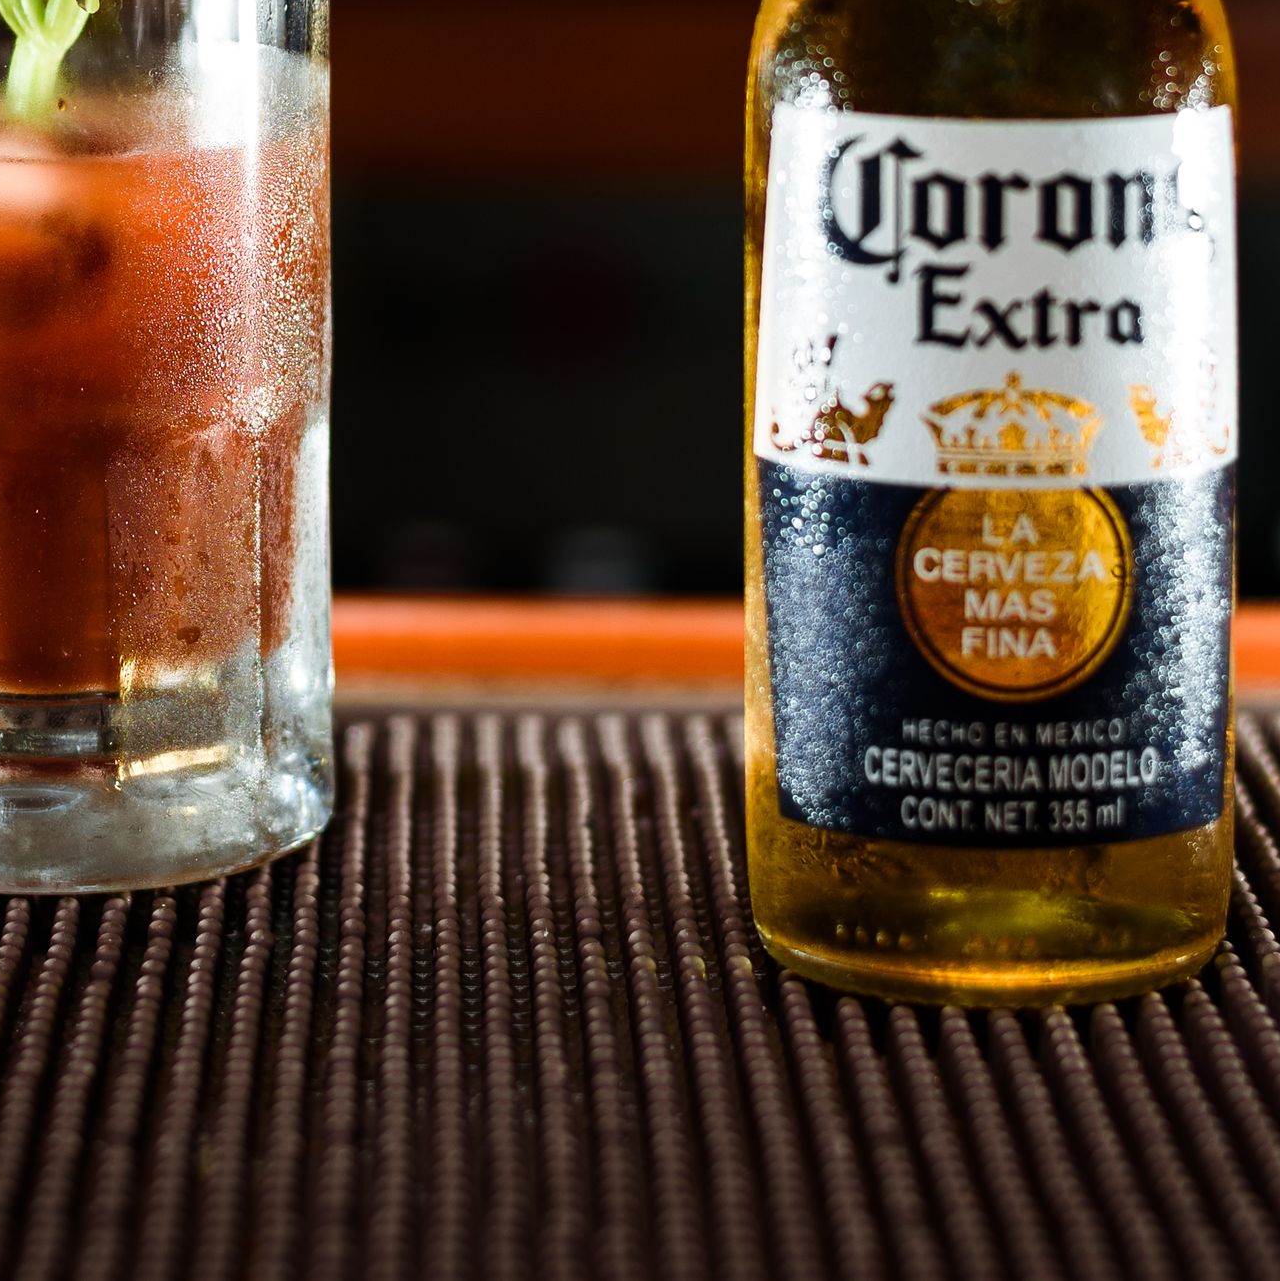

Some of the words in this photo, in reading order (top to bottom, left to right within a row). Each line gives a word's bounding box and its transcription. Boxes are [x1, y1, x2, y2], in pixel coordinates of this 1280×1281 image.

[819, 133, 1194, 284] Coron
[915, 262, 1147, 348] Extra
[981, 513, 1040, 546] LA
[913, 546, 1106, 584] CERVEZA
[963, 588, 1057, 622] MAS
[960, 626, 1057, 660] FINA
[901, 718, 986, 747] HECHO
[994, 721, 1028, 747] EN
[1035, 718, 1124, 748] MEXICO
[864, 745, 1041, 793] CERVECERIA
[1048, 746, 1158, 792] MODELO
[1047, 799, 1090, 832] 355
[1096, 796, 1126, 827] ml
